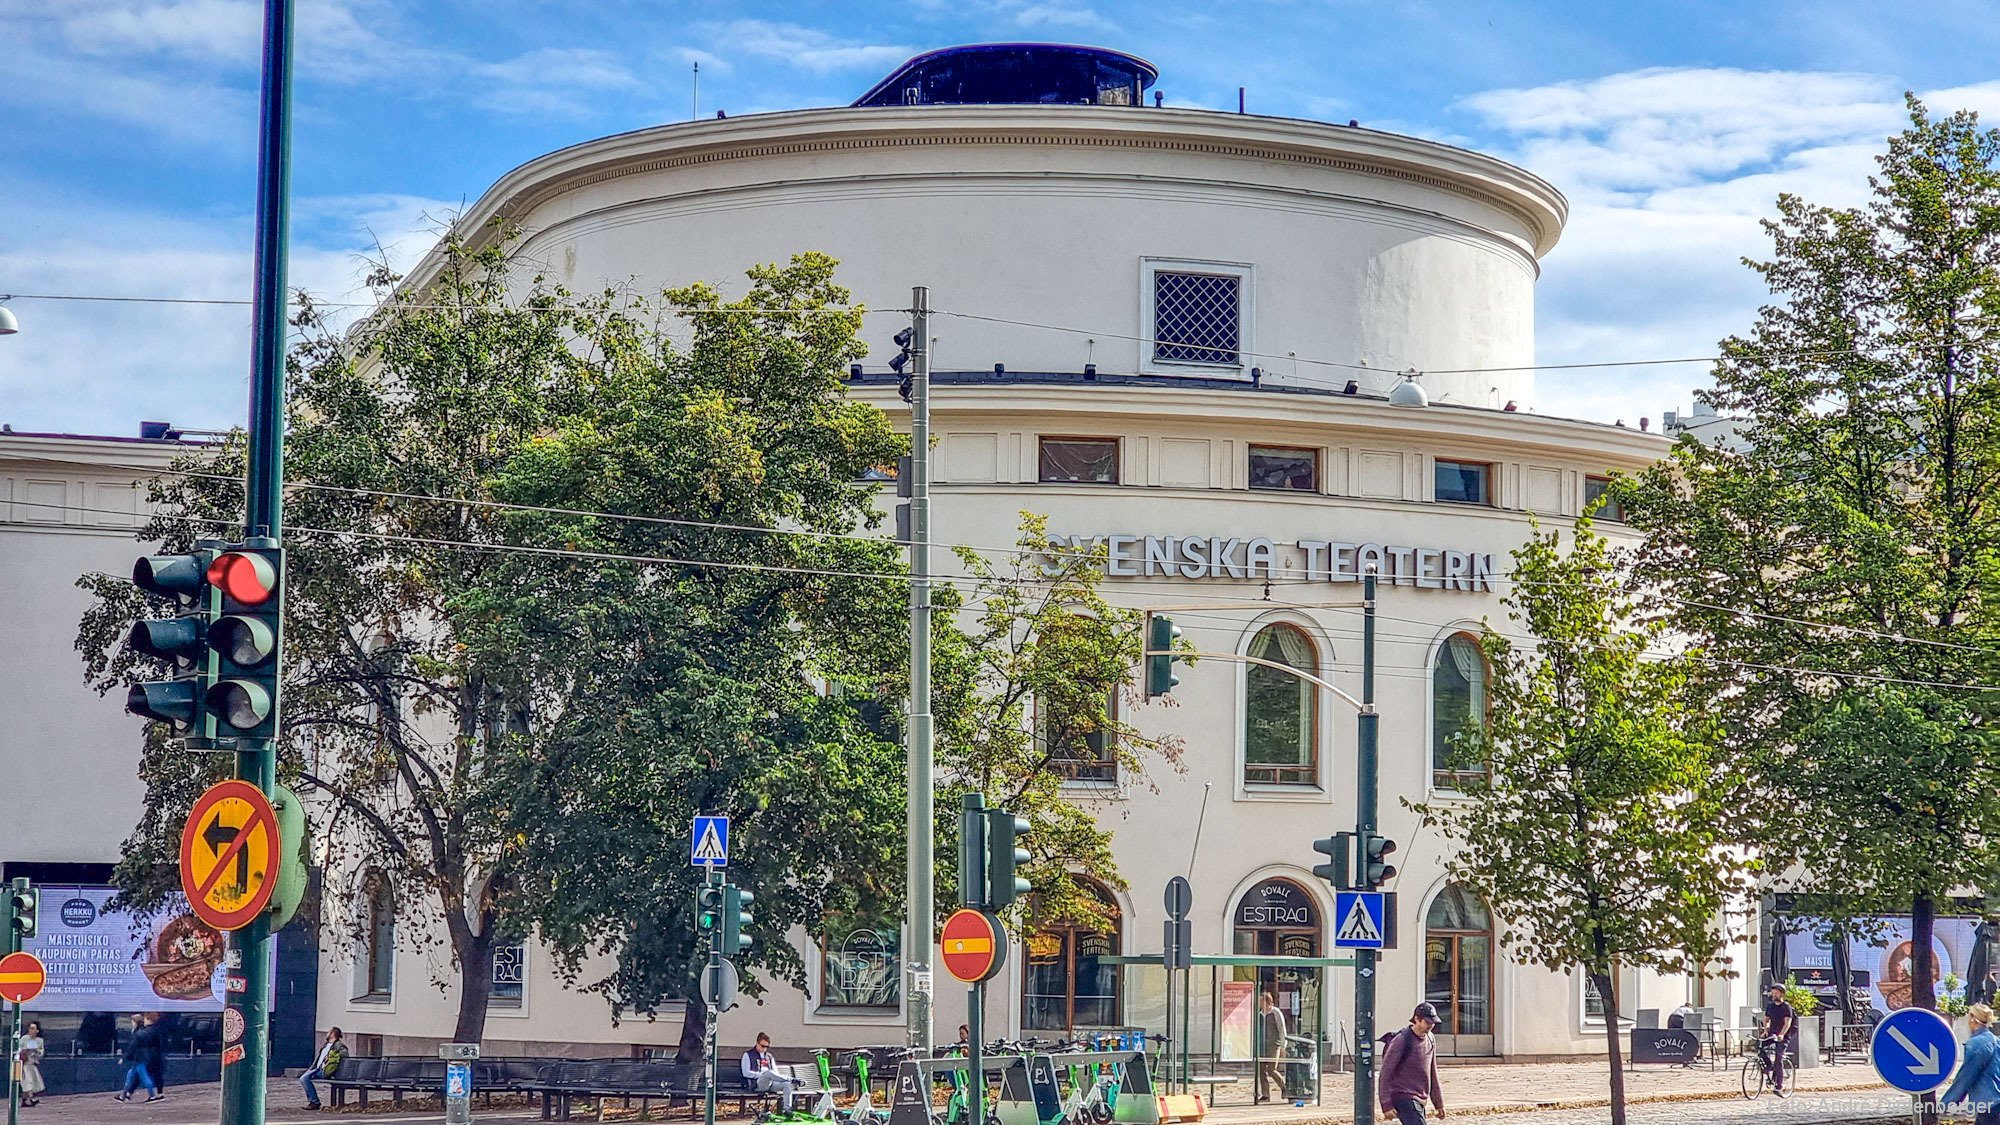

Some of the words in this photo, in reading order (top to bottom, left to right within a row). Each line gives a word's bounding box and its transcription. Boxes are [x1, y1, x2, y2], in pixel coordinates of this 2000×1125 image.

[1297, 540, 1497, 592] TEATERN
[1260, 885, 1291, 898] ROYALE
[63, 907, 93, 916] HERKKU
[1243, 906, 1308, 923] ESTRAD
[47, 934, 109, 946] MAISTUISIKO
[35, 948, 87, 960] KAUPUNGIN
[91, 949, 121, 960] PARAS
[78, 963, 136, 975] BISTROSSA?
[1654, 1038, 1688, 1050] ROYALE
